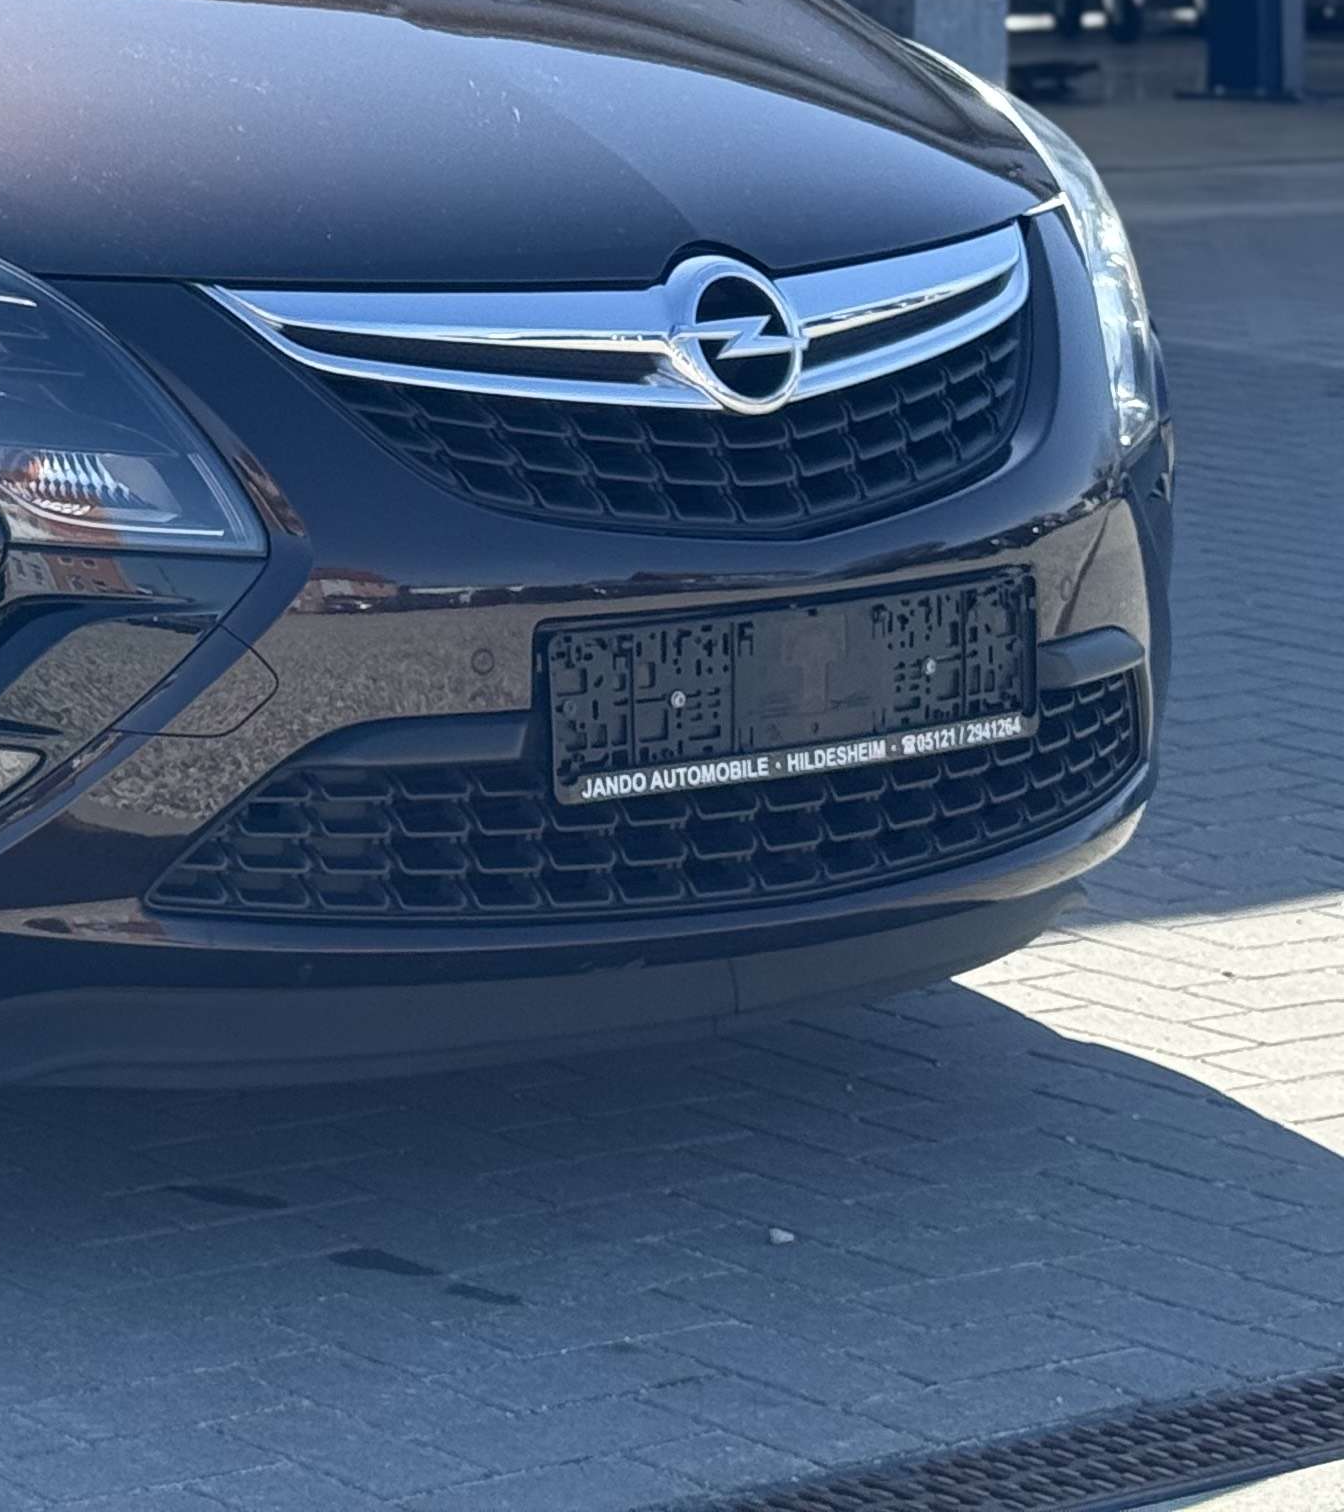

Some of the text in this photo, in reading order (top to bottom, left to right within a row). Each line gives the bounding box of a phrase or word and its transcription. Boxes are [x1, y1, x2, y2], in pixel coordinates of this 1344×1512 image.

[581, 772, 647, 799] JANDO
[650, 756, 769, 790] AUTOMOBILE
[787, 739, 887, 773] HILDESHEIM
[917, 727, 956, 753] 05121
[966, 716, 1022, 743] 2941264
